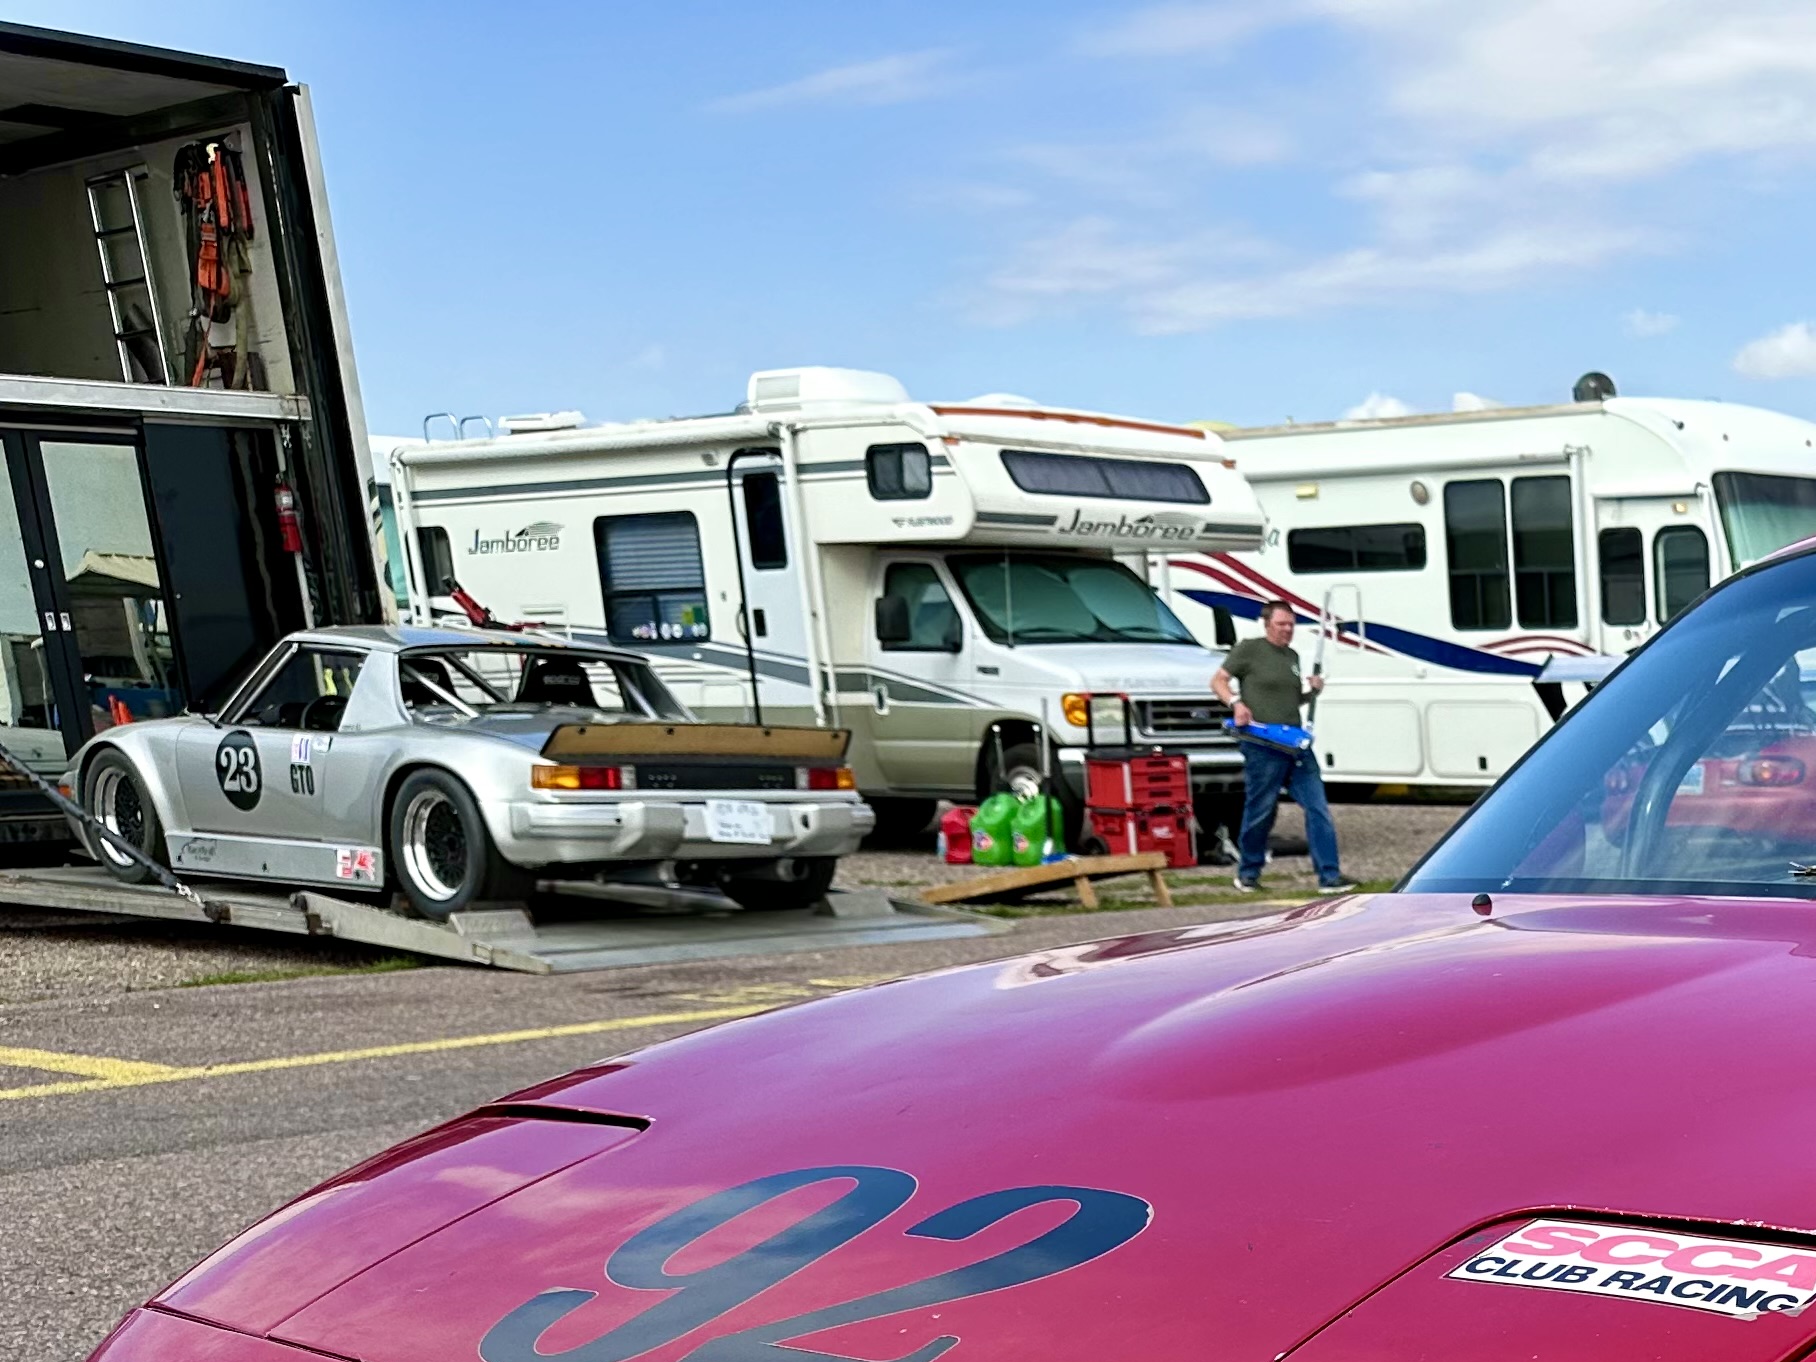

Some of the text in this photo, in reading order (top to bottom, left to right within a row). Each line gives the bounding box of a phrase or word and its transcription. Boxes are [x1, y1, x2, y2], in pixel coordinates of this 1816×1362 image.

[1058, 508, 1196, 541] Jamboree
[468, 528, 559, 555] Jamboree
[220, 746, 258, 793] 23
[290, 764, 315, 796] GTO
[1464, 1256, 1800, 1315] CLUB RACING
